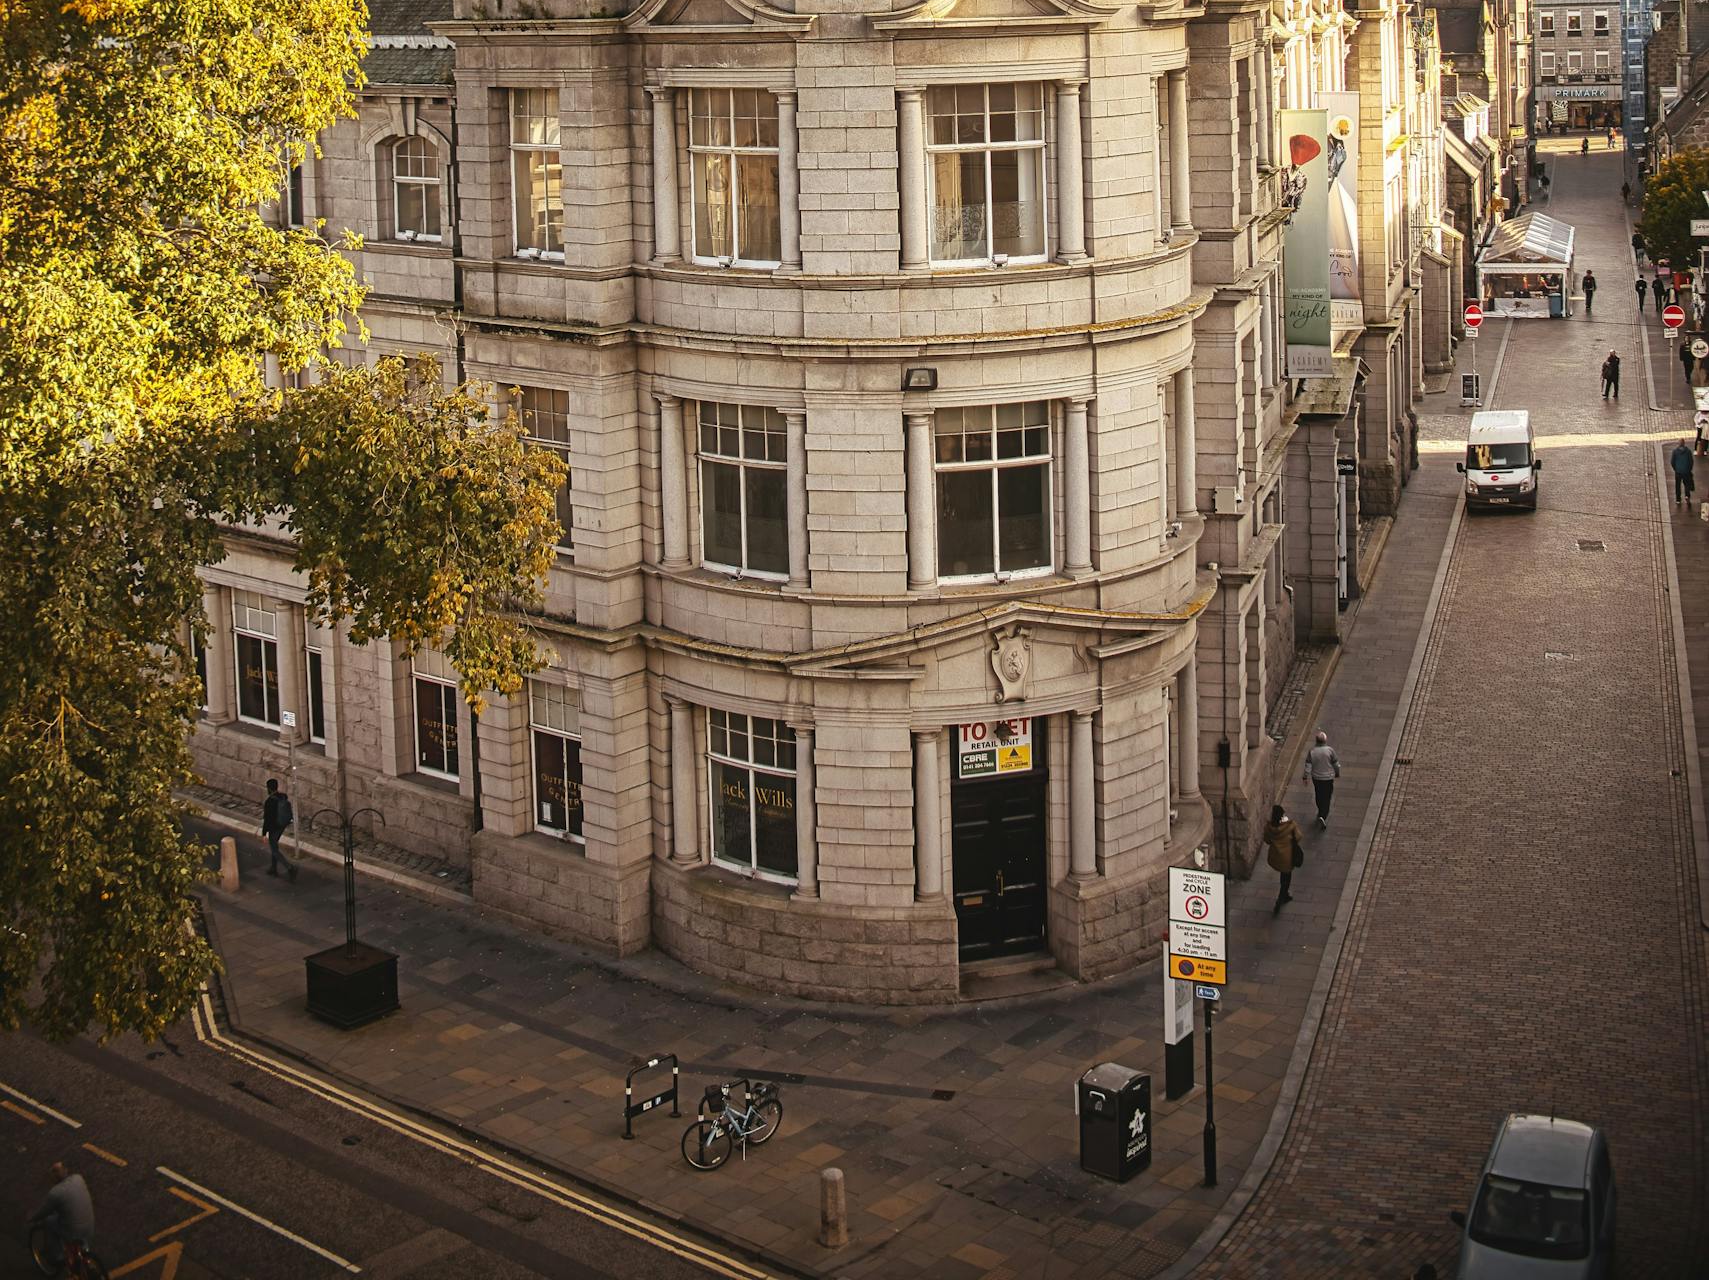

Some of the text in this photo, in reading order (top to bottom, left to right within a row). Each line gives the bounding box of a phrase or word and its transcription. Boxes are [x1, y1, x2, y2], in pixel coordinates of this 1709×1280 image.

[1555, 89, 1607, 97] PRIMARK
[1289, 302, 1327, 329] night
[960, 722, 987, 742] TO
[971, 738, 1020, 750] RETAIL UNIT
[963, 753, 988, 763] CBRE
[541, 773, 582, 791] OUTFTTE
[755, 786, 793, 809] Wills
[1183, 883, 1211, 895] ZONE
[1176, 924, 1192, 932] Except
[1192, 943, 1211, 951] loading
